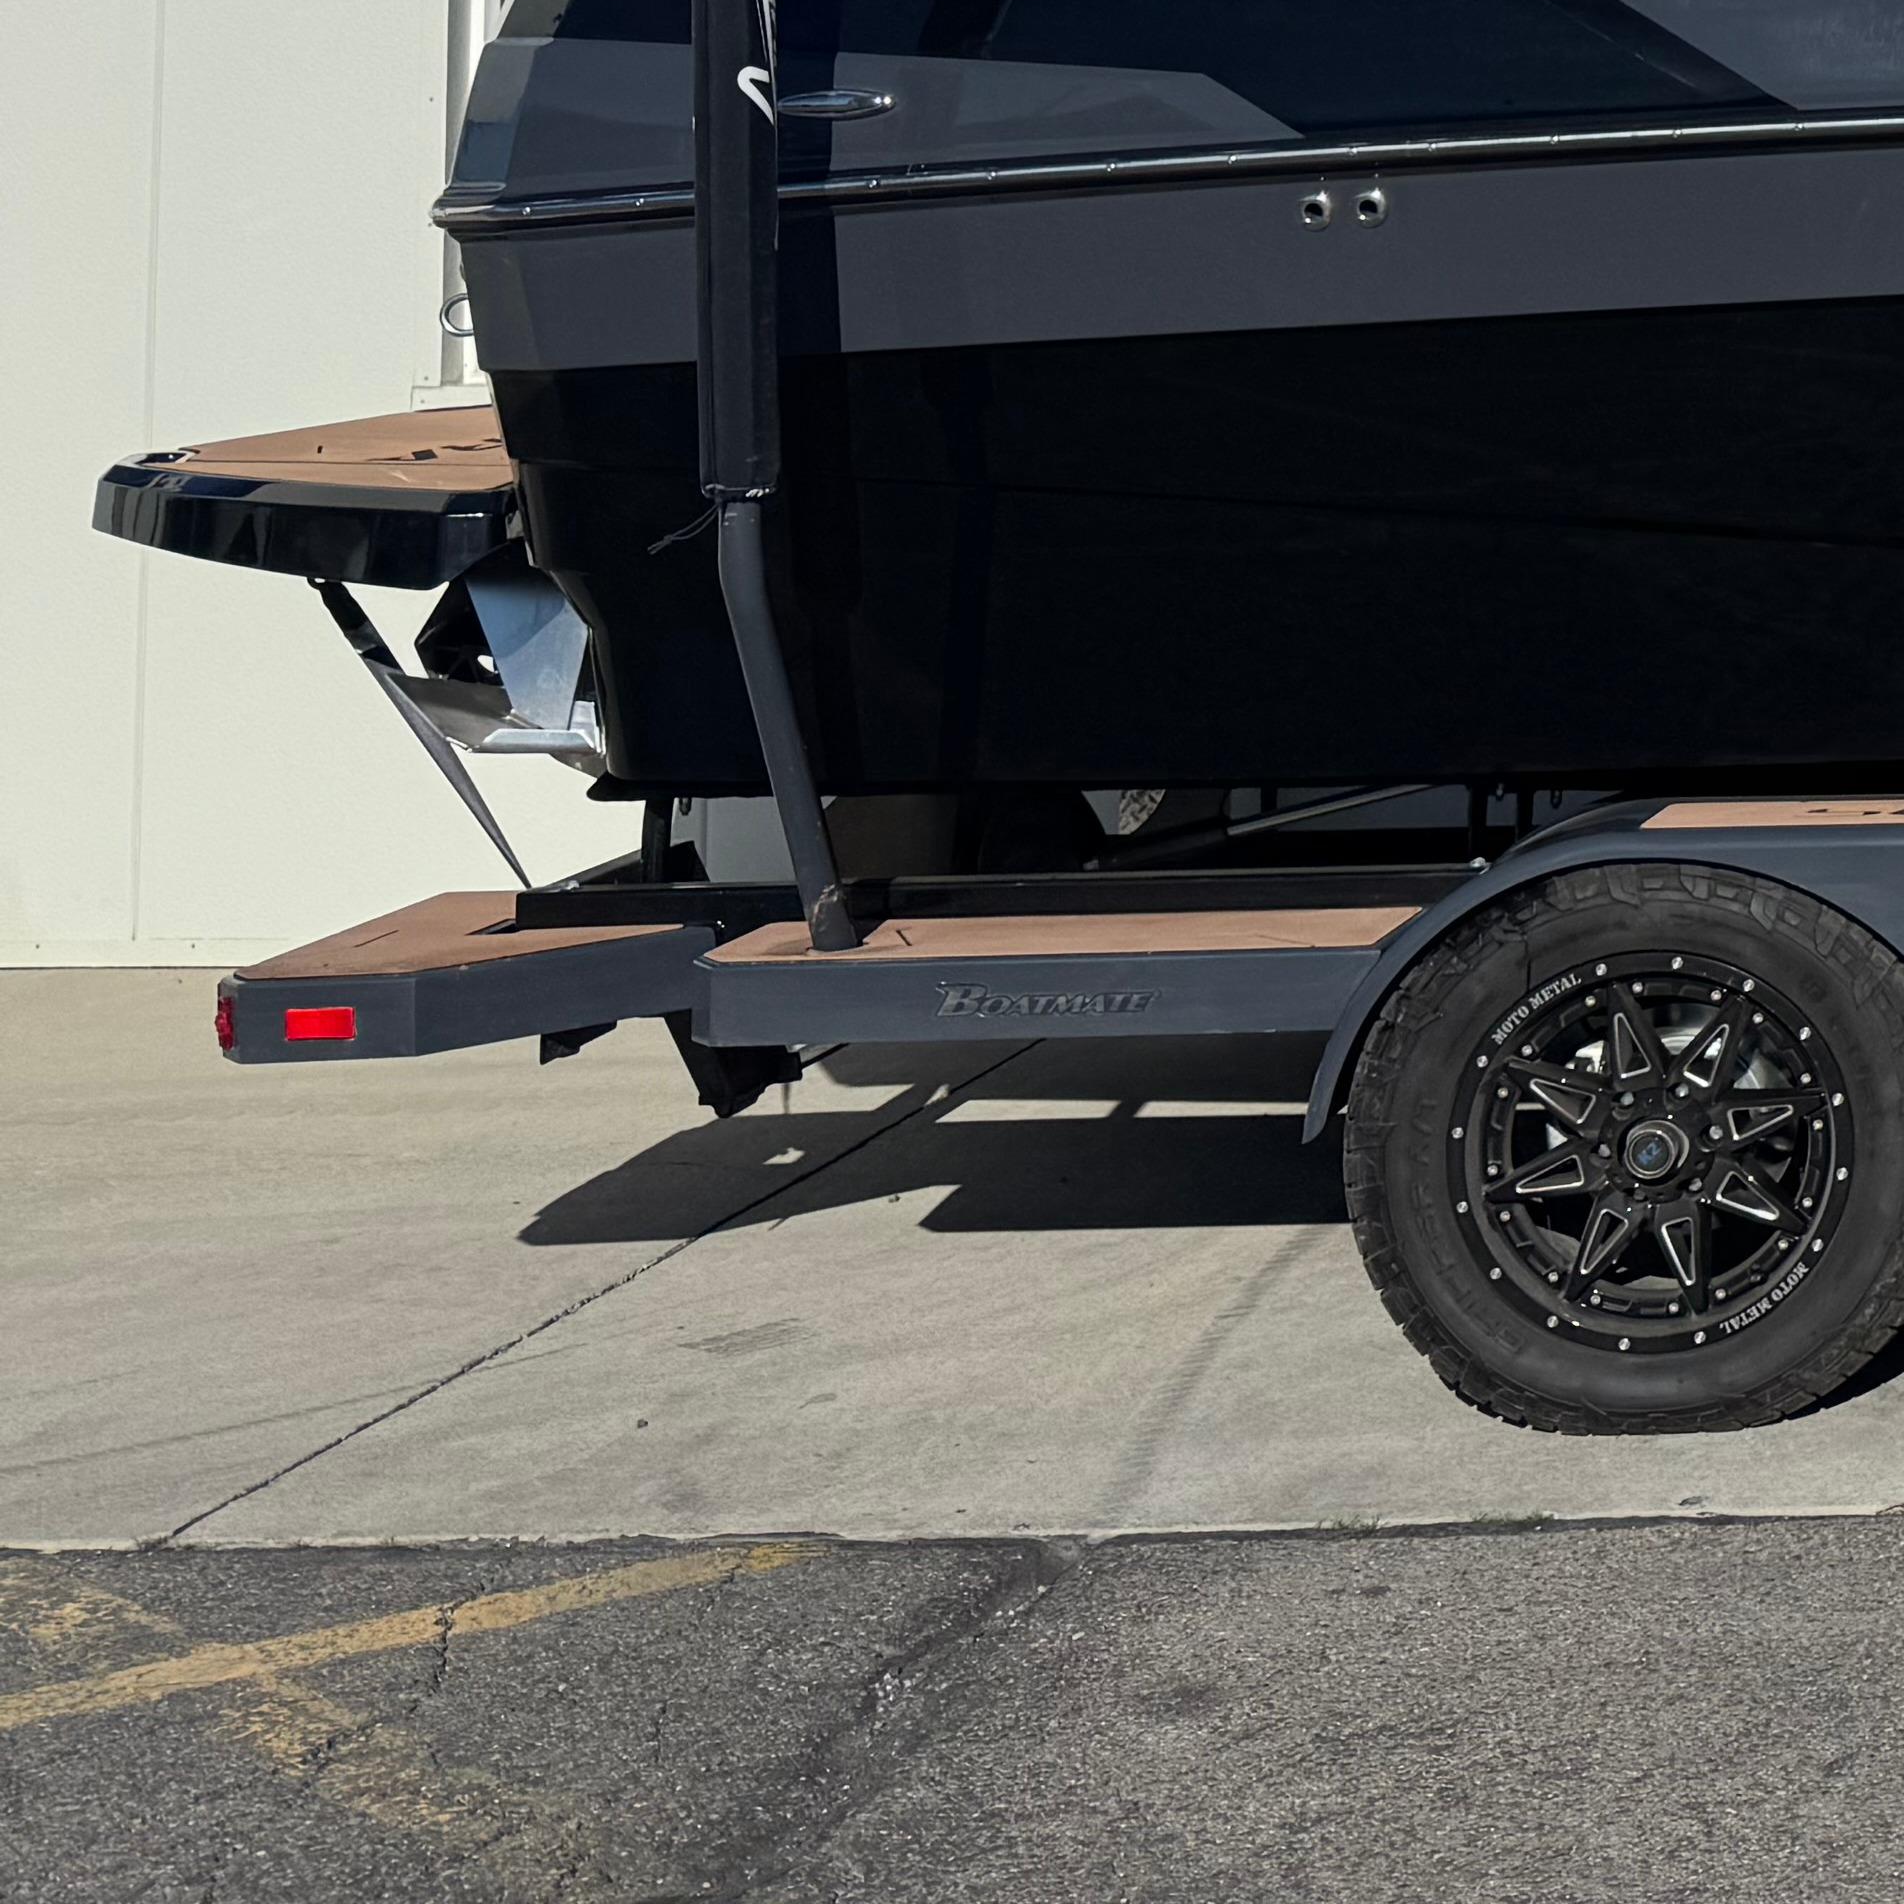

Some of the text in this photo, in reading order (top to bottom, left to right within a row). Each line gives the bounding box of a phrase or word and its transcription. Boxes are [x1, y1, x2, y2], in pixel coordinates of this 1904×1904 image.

[1491, 973, 1582, 1045] MOTO METAL
[1719, 1261, 1810, 1334] MOTO METAL
